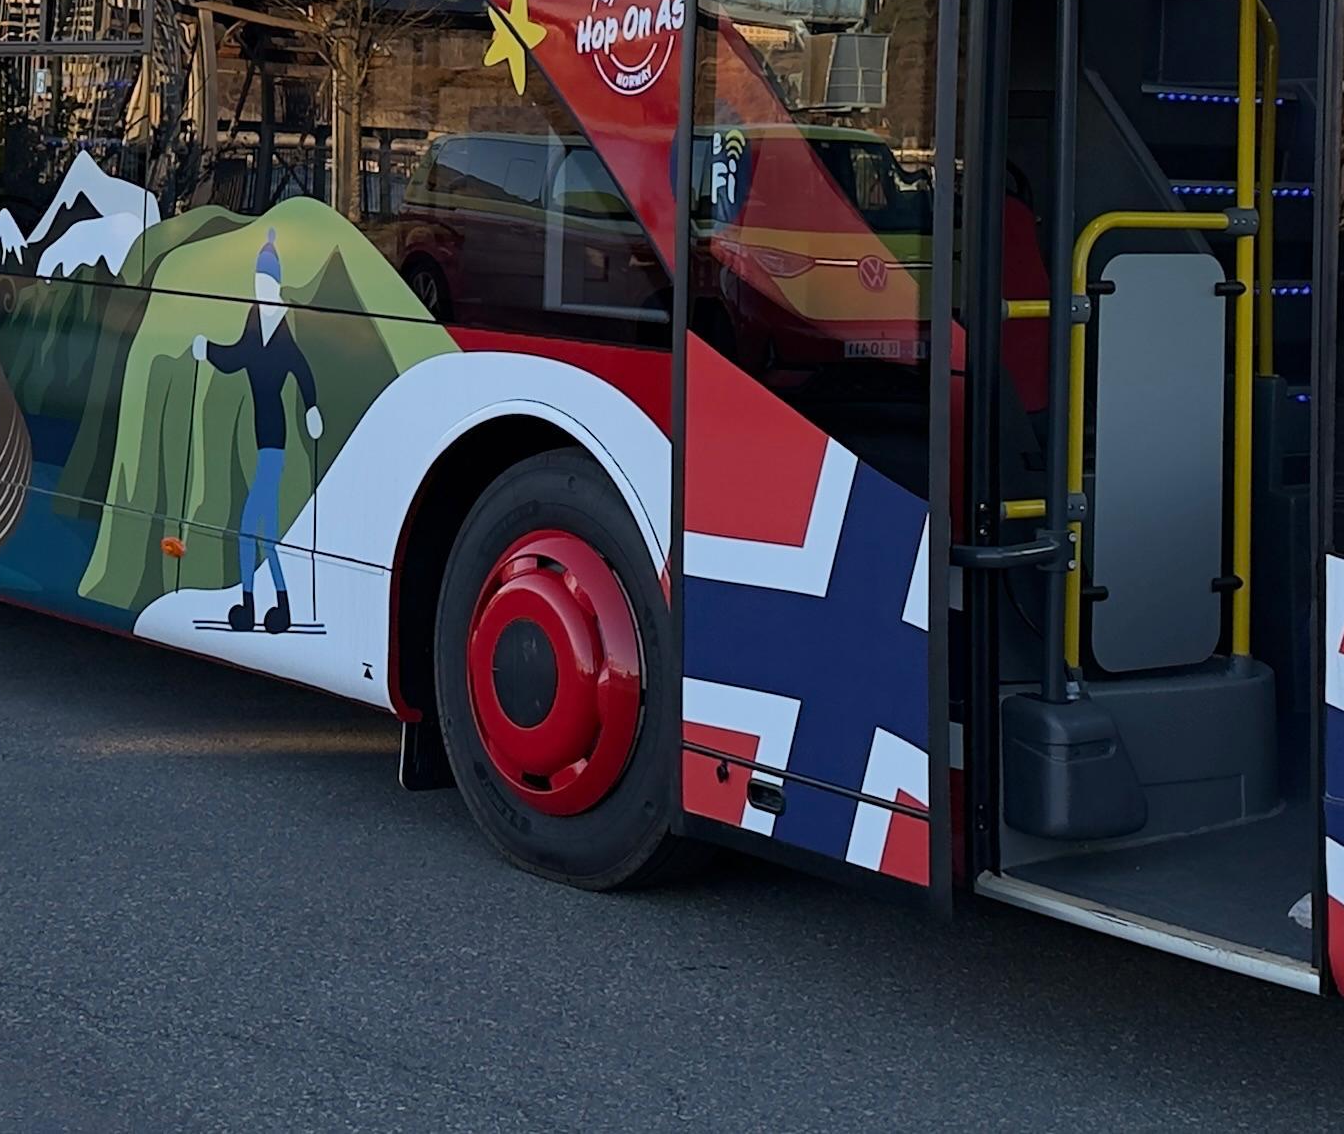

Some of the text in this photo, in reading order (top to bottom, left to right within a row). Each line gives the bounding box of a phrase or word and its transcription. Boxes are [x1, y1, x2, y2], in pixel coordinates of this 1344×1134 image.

[576, 15, 619, 56] Hop
[622, 5, 652, 42] On
[615, 64, 654, 89] NORWAY
